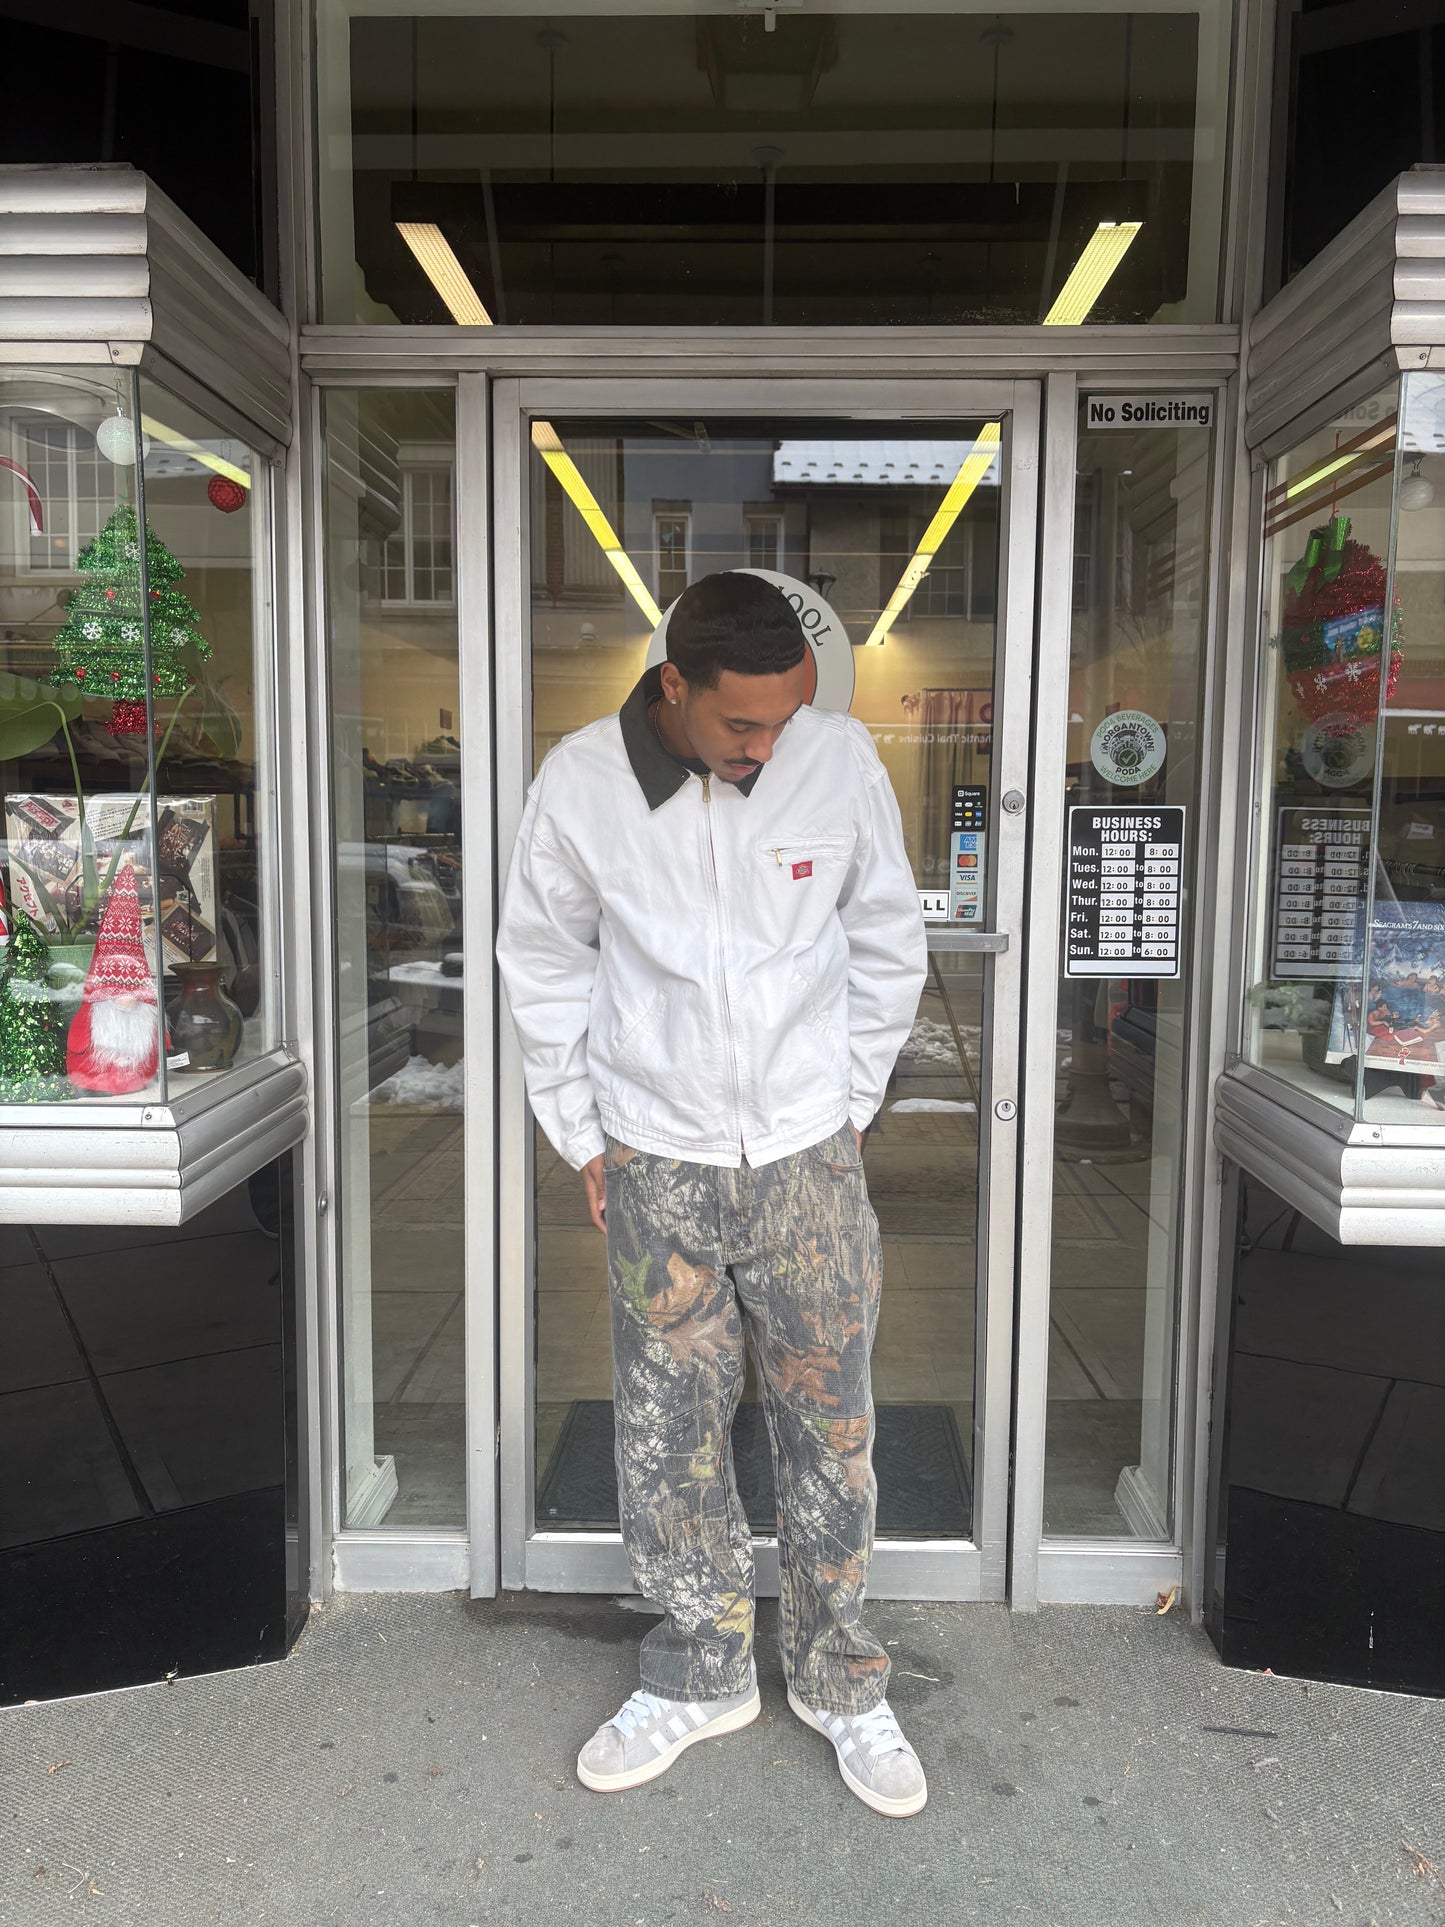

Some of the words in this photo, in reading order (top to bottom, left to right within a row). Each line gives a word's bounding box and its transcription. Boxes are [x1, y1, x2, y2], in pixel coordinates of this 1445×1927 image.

[1091, 403, 1115, 422] No
[1121, 401, 1210, 425] Soliciting
[778, 586, 831, 647] OOL
[1096, 718, 1116, 738] PODA
[1116, 713, 1159, 734] BEVERAGES
[1100, 765, 1137, 783] WELCOME
[1139, 763, 1157, 779] HERE
[1115, 767, 1141, 775] PODA
[1092, 817, 1161, 829] BUSINESS
[1101, 830, 1152, 842] HOURS:
[1073, 846, 1099, 856] Mon.
[1072, 862, 1100, 873] Tues.
[1072, 879, 1098, 889] Wed.
[1072, 895, 1098, 906] Thur.
[1134, 897, 1143, 905] to
[1070, 912, 1088, 922] Fri.
[1070, 928, 1091, 939] Sat.
[1070, 945, 1094, 955] Sun.
